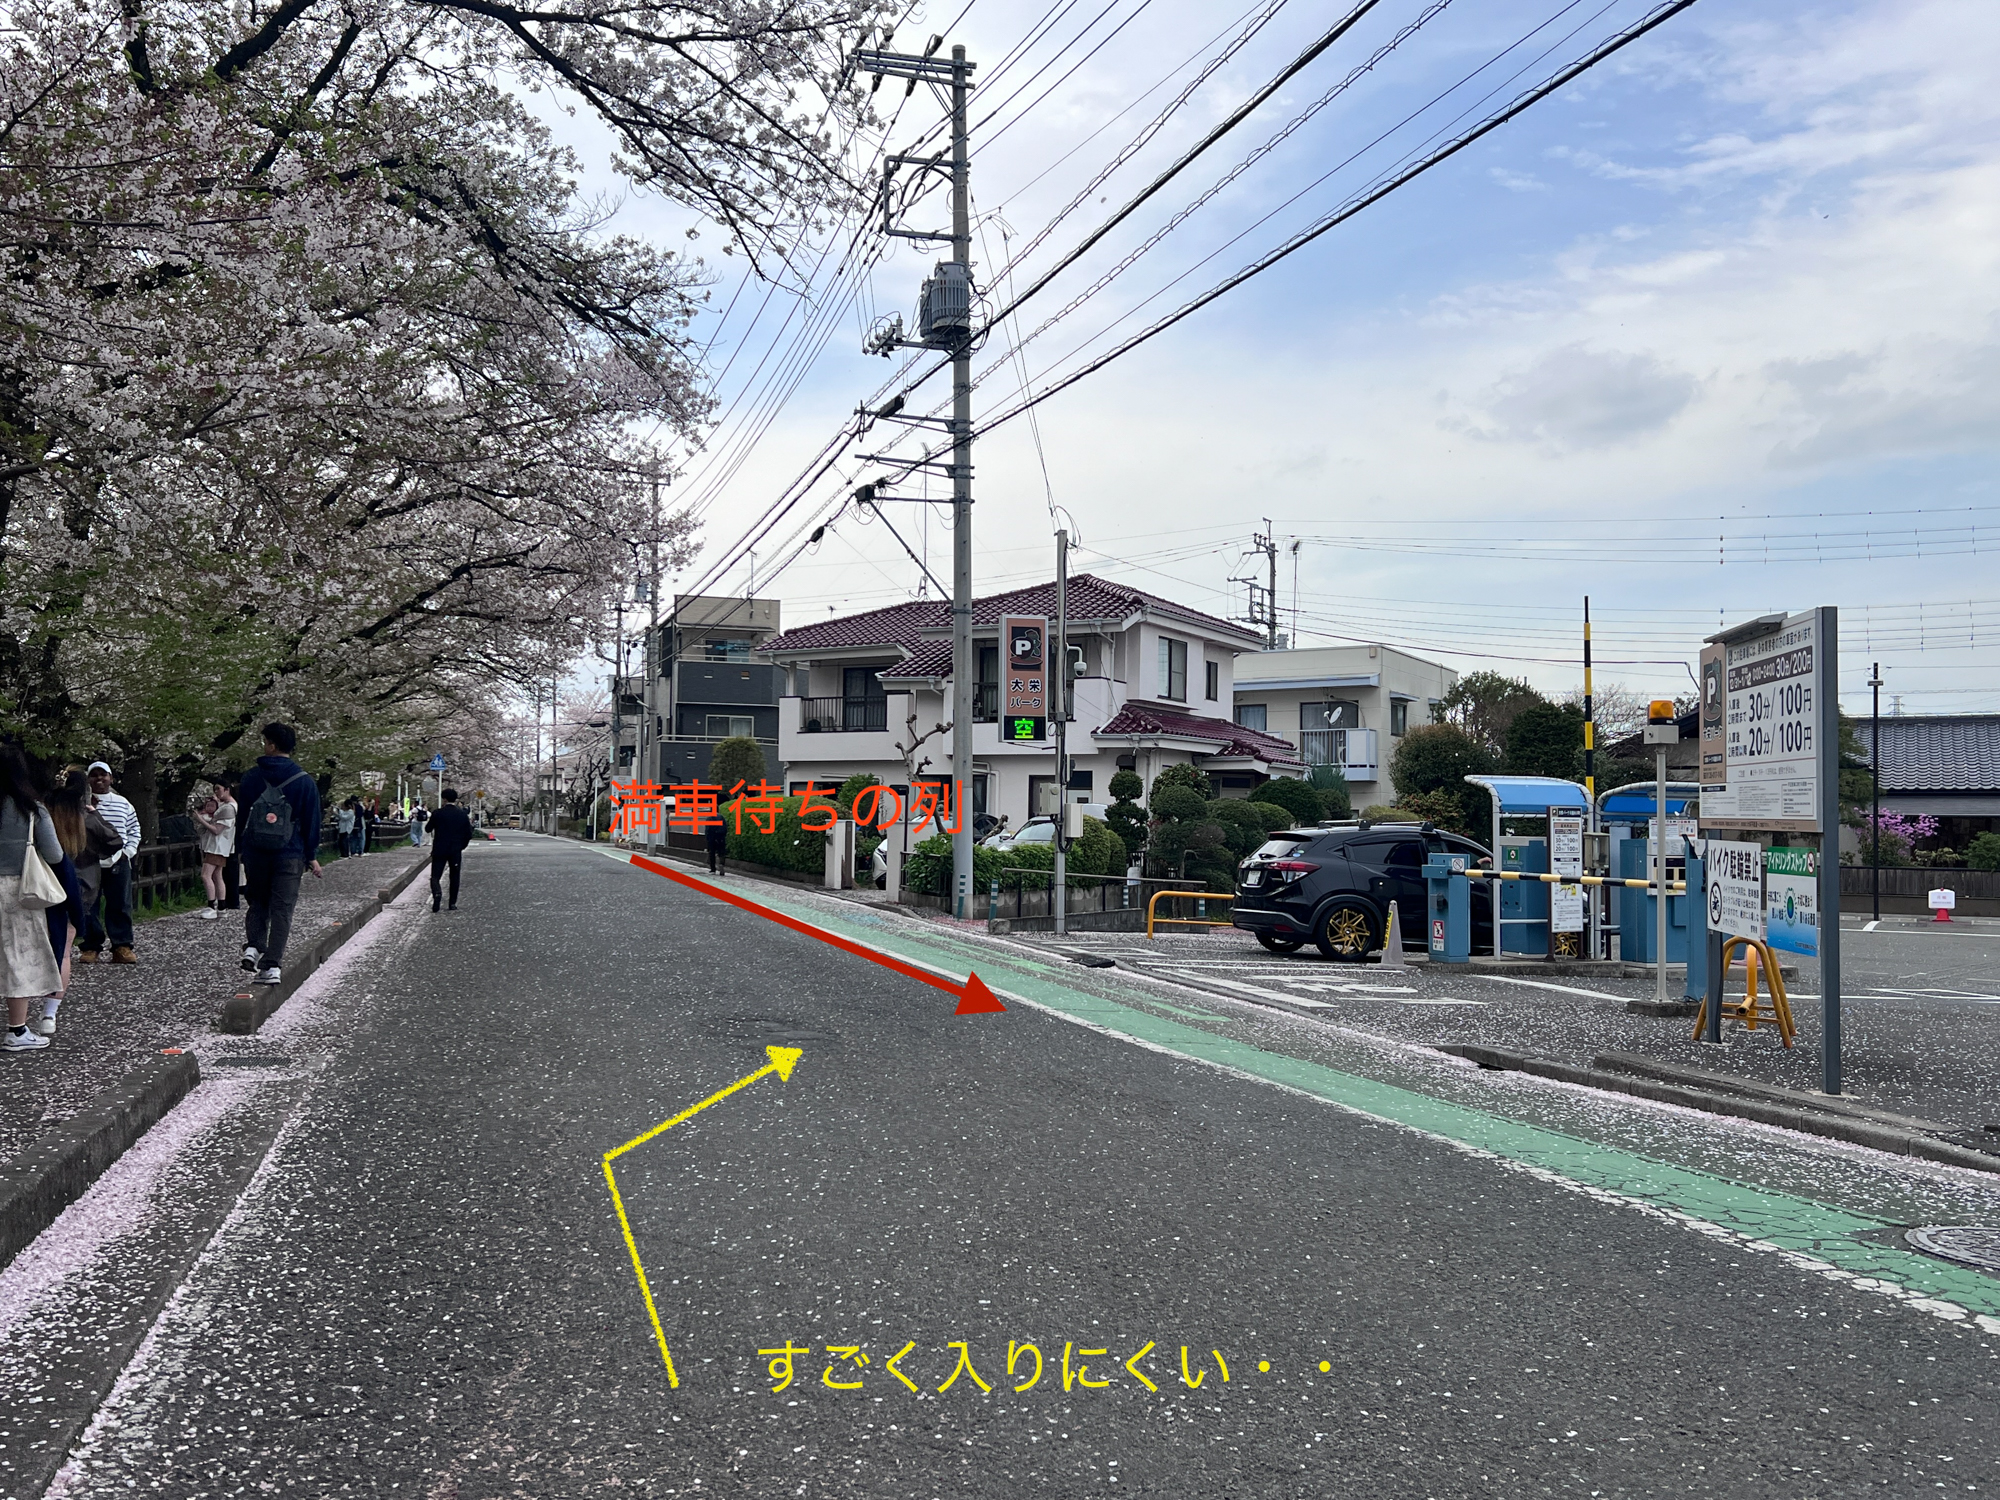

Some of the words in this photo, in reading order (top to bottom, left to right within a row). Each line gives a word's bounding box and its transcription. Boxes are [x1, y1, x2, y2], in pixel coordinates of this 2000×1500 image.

[1015, 640, 1031, 656] P
[1011, 678, 1042, 693] 大栄
[1707, 677, 1716, 704] P
[1010, 696, 1042, 709] パーク
[1014, 718, 1035, 739] 空
[1709, 847, 1759, 882] バイク駐輪禁止
[1767, 851, 1807, 872] アイドリングストップ
